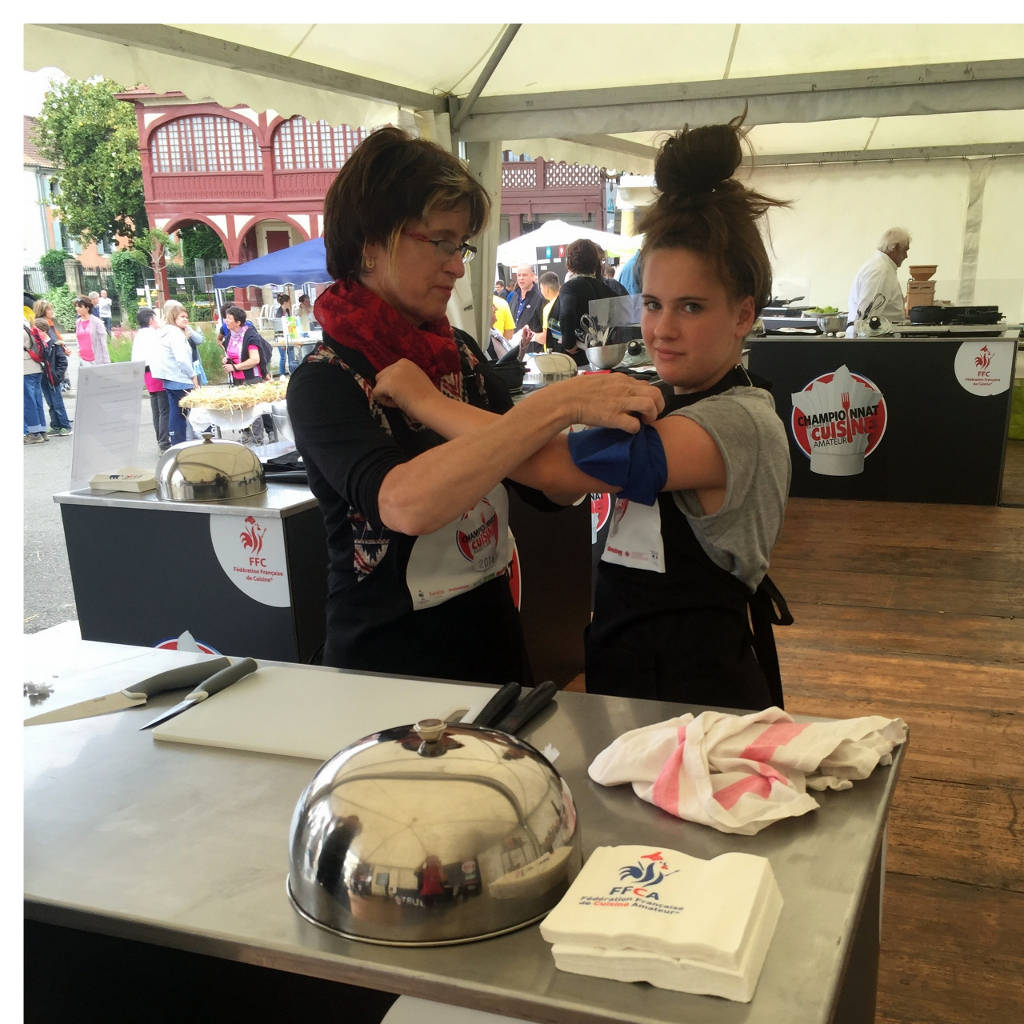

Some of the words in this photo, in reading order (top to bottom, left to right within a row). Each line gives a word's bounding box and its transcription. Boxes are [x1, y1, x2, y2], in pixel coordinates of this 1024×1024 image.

[797, 405, 878, 427] CHAMPIONNAT
[811, 417, 875, 443] CUISINE
[249, 556, 267, 568] FFC
[609, 885, 660, 901] FFCA
